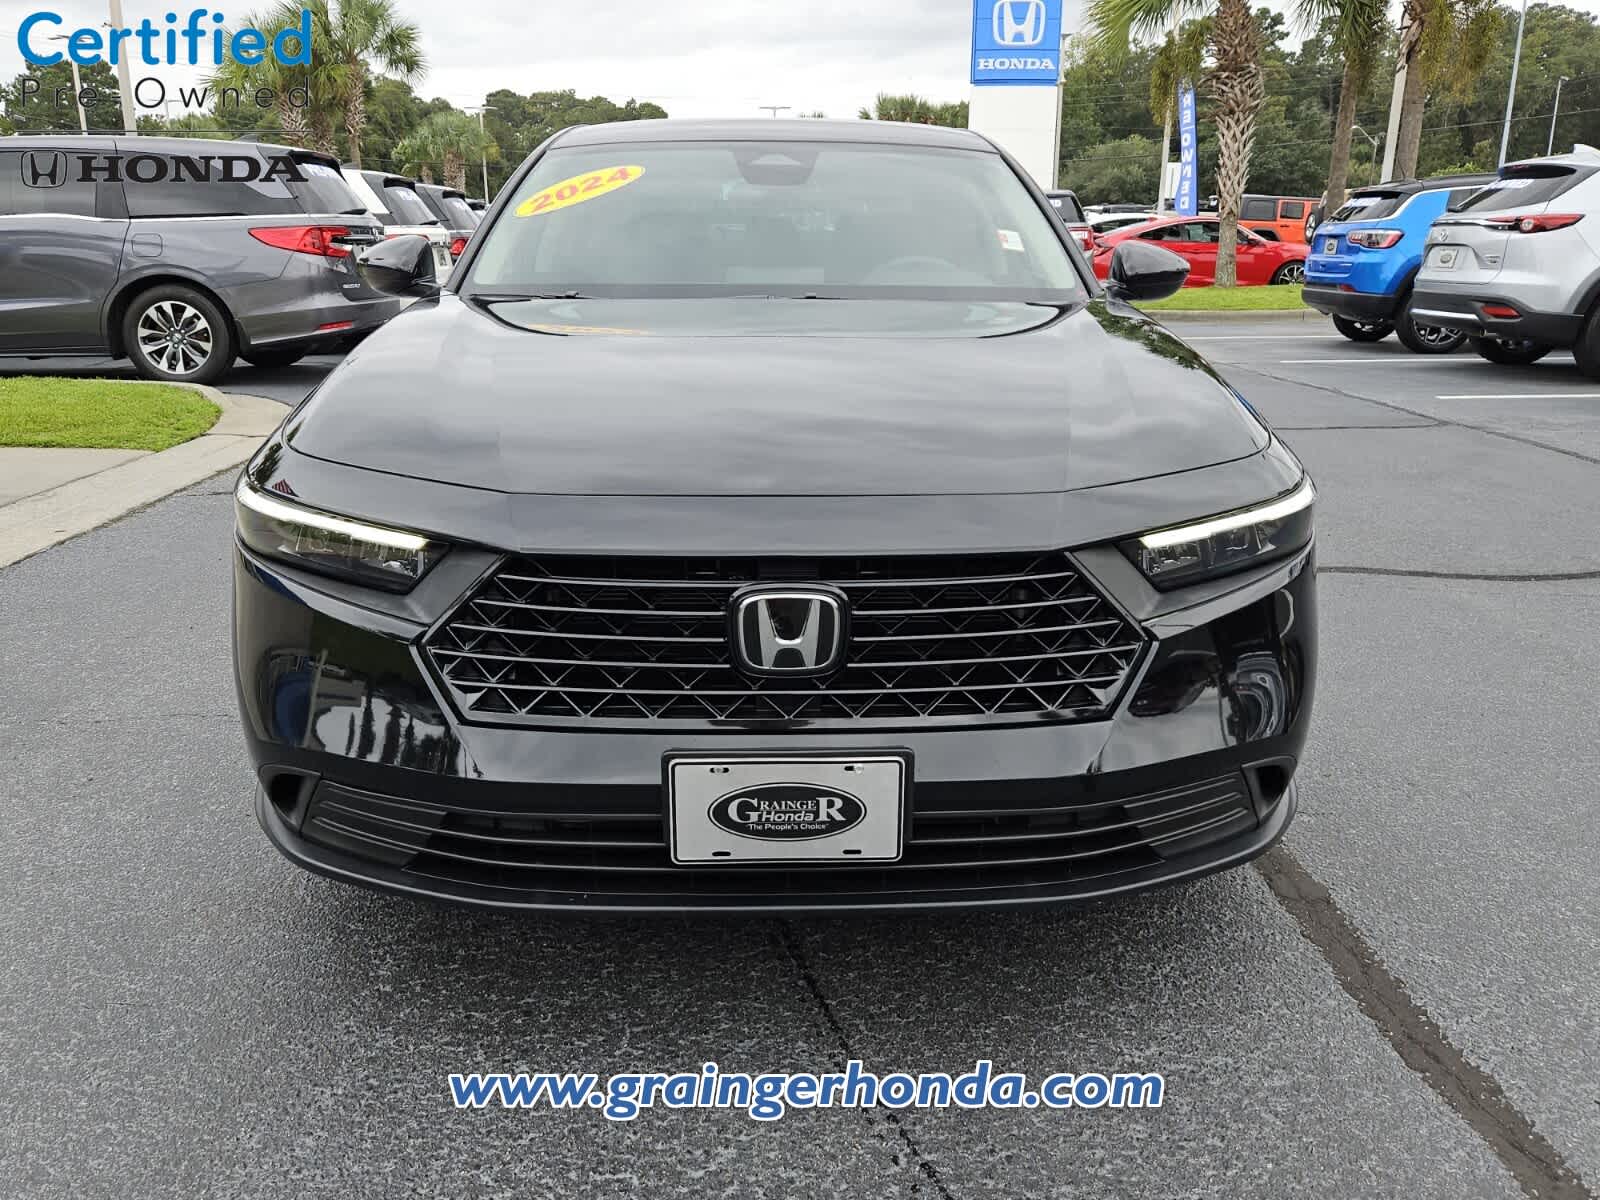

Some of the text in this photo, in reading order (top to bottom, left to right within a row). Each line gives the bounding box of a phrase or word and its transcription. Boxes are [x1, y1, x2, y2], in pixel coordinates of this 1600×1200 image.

[977, 58, 1055, 70] HONDA
[529, 167, 632, 213] 2024
[727, 797, 846, 824] GRAINGER
[760, 810, 815, 822] Honda
[764, 823, 798, 831] People's
